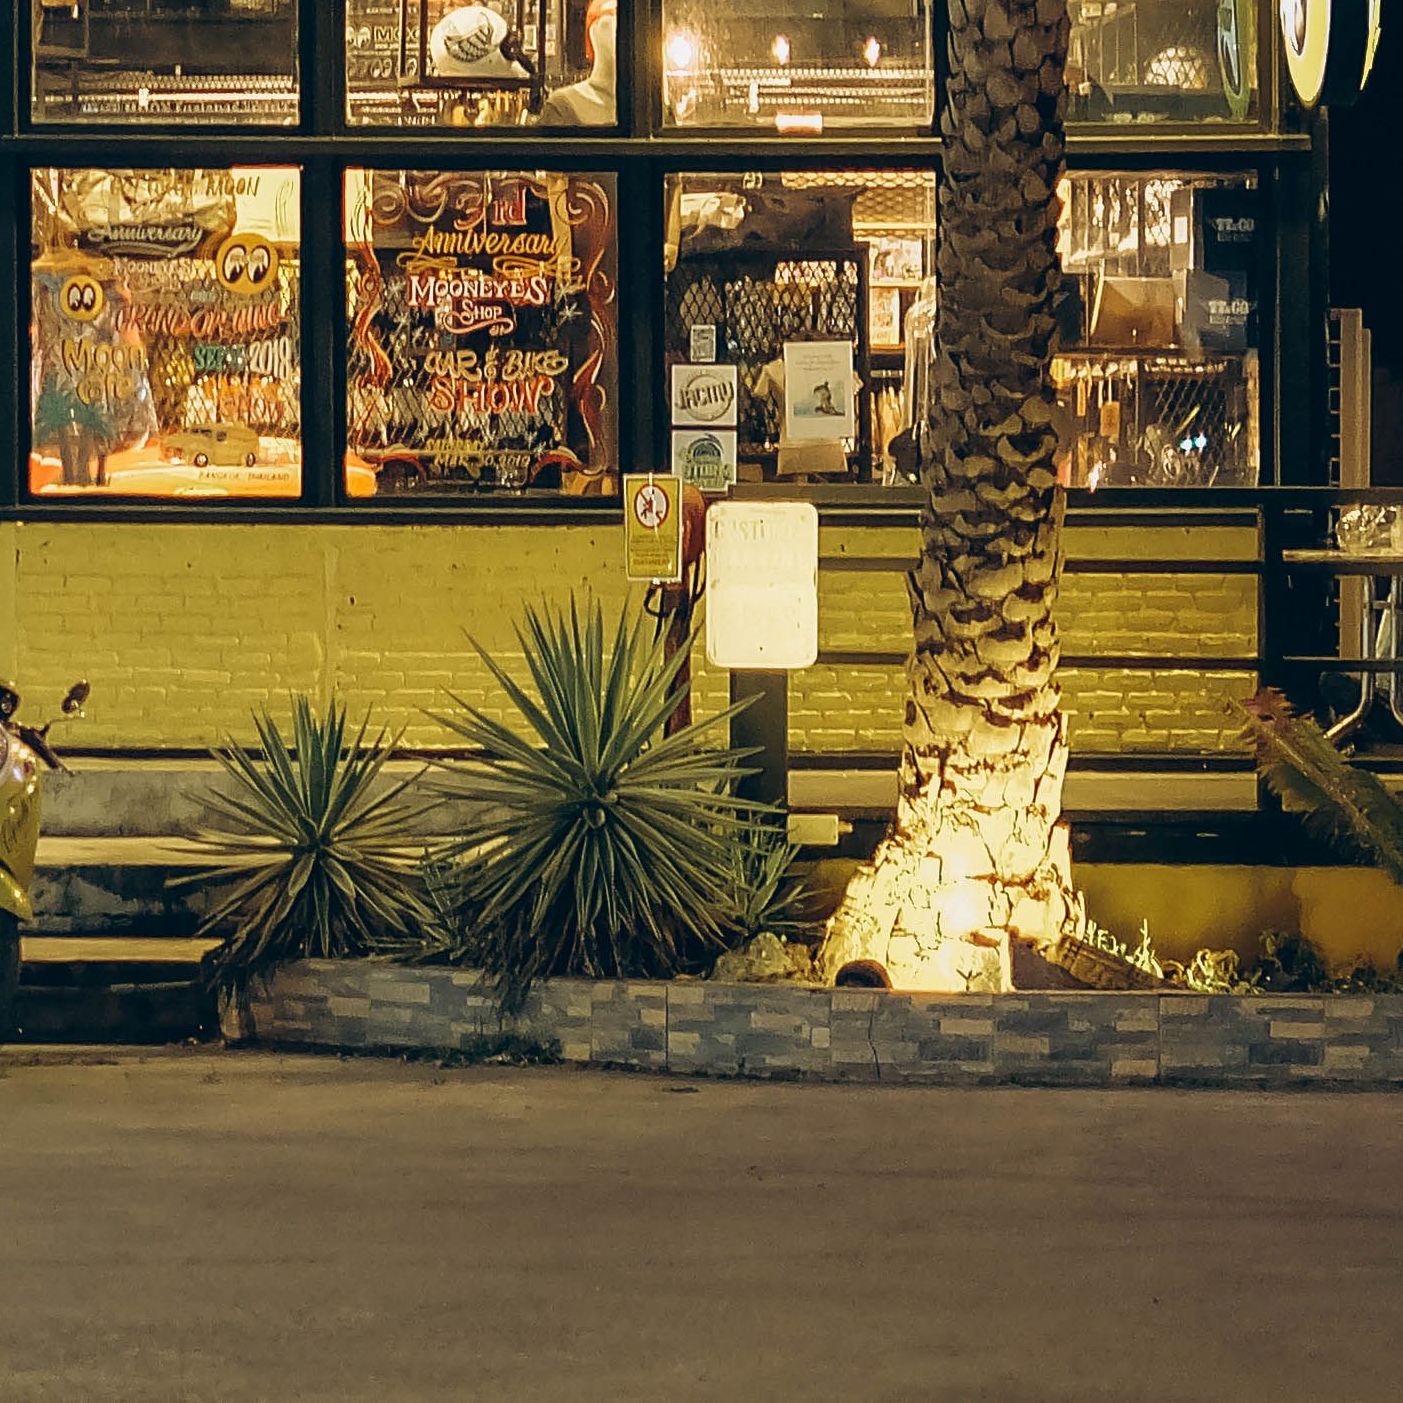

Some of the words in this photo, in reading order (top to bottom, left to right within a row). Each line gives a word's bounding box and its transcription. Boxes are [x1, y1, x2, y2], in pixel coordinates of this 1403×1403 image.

[87, 222, 203, 245] Anniversary
[408, 274, 549, 306] MOONEYES
[460, 299, 503, 325] SHOP
[248, 336, 290, 378] 2018
[430, 375, 555, 414] SHOW
